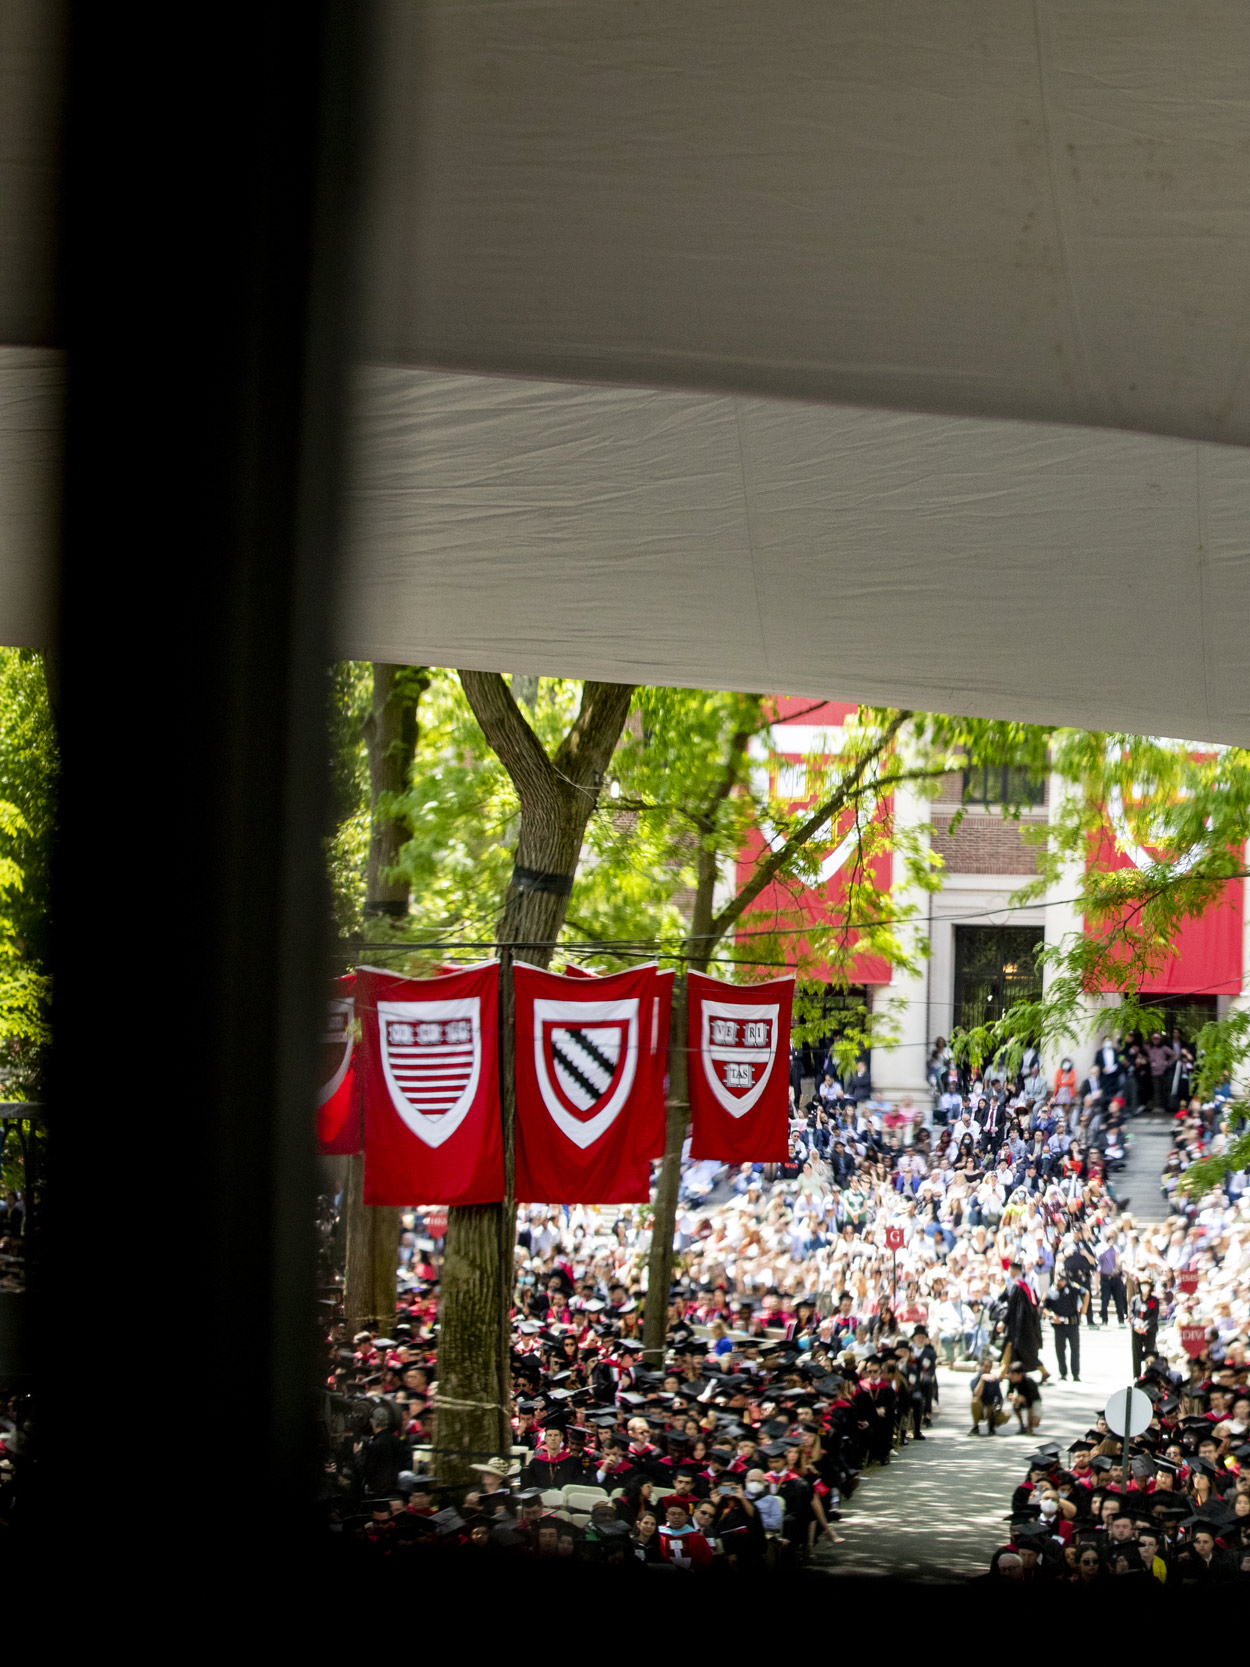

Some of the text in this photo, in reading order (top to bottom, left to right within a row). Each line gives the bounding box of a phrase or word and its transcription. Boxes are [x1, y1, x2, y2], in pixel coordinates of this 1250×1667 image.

[717, 1025, 761, 1038] VE RI
[731, 1068, 748, 1079] TAS
[890, 1230, 900, 1243] G
[1182, 1329, 1204, 1341] DIV
